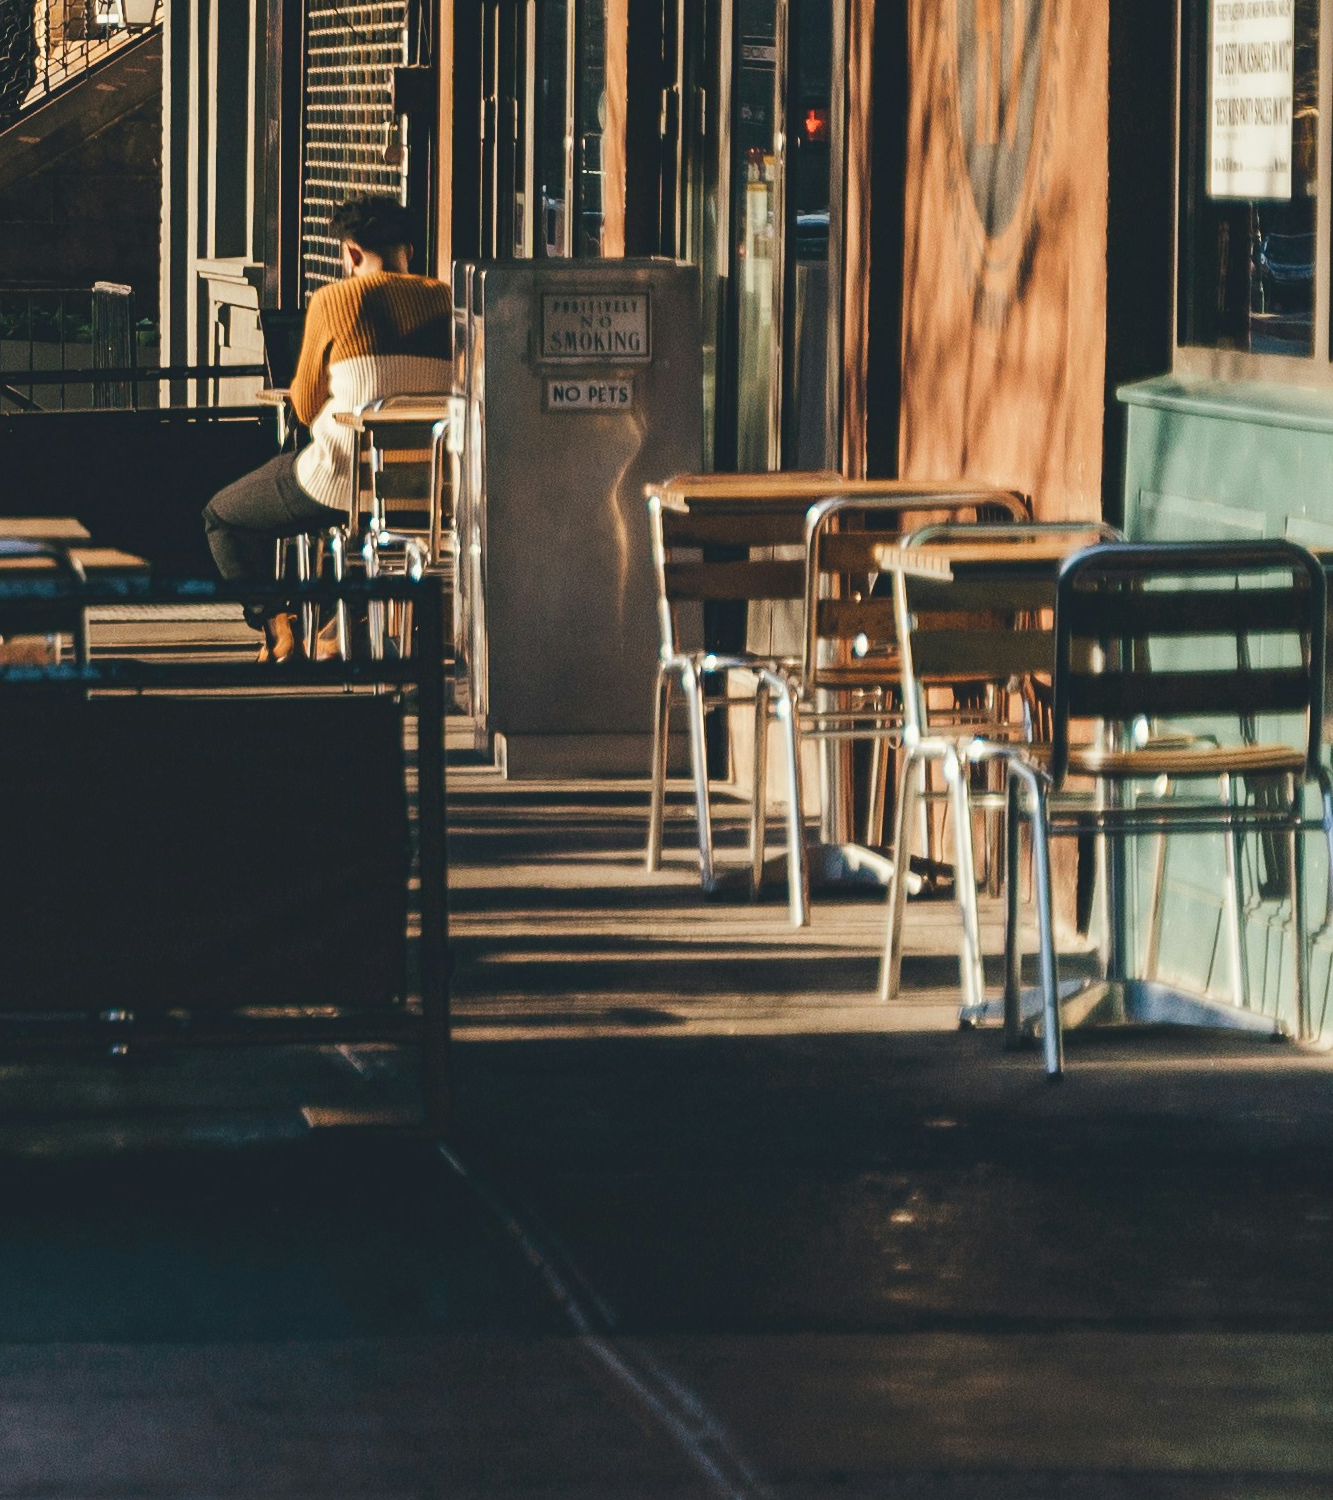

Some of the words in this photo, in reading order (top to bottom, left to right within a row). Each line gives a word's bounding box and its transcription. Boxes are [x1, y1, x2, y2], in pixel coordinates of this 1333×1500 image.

[553, 301, 638, 313] POSITIVELY
[580, 316, 613, 328] NO
[549, 330, 641, 351] SMOKING
[553, 386, 581, 401] NO
[588, 386, 629, 403] PETS
